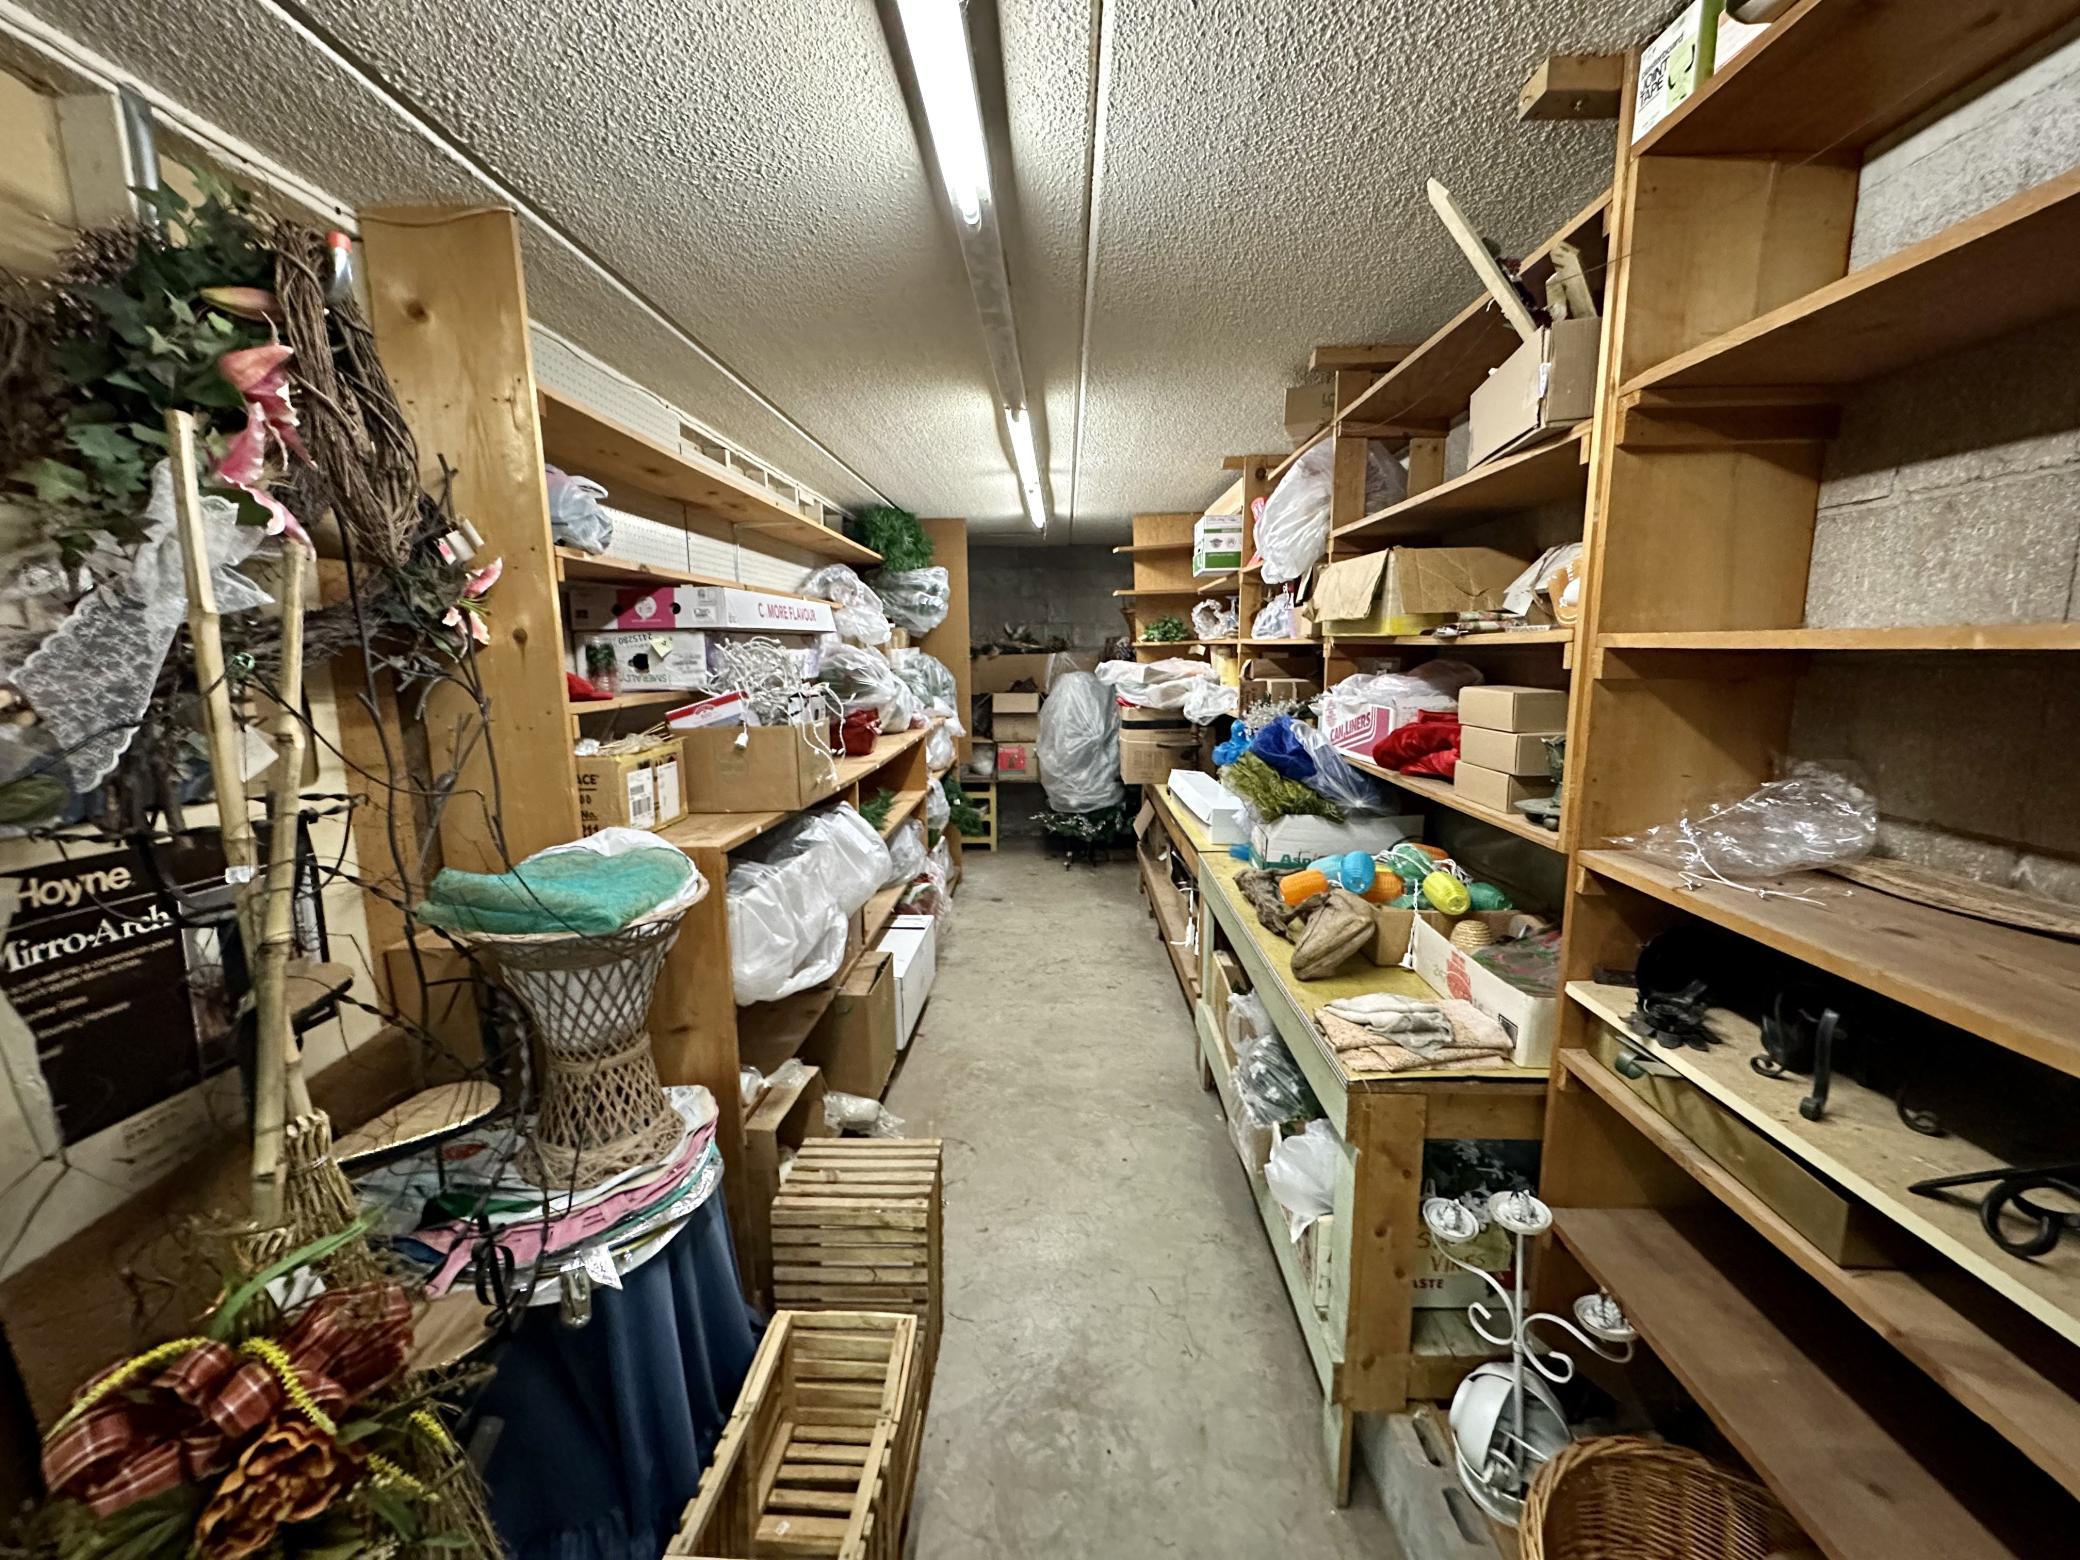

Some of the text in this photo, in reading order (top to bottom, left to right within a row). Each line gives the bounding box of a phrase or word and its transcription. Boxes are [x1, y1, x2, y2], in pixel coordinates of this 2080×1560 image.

[1643, 56, 1670, 91] JOINT
[1640, 76, 1664, 107] TAPE
[767, 604, 788, 620] MORE
[788, 606, 817, 622] FLAVOUR
[1345, 712, 1371, 735] LINERS
[18, 866, 132, 908] Hoyne
